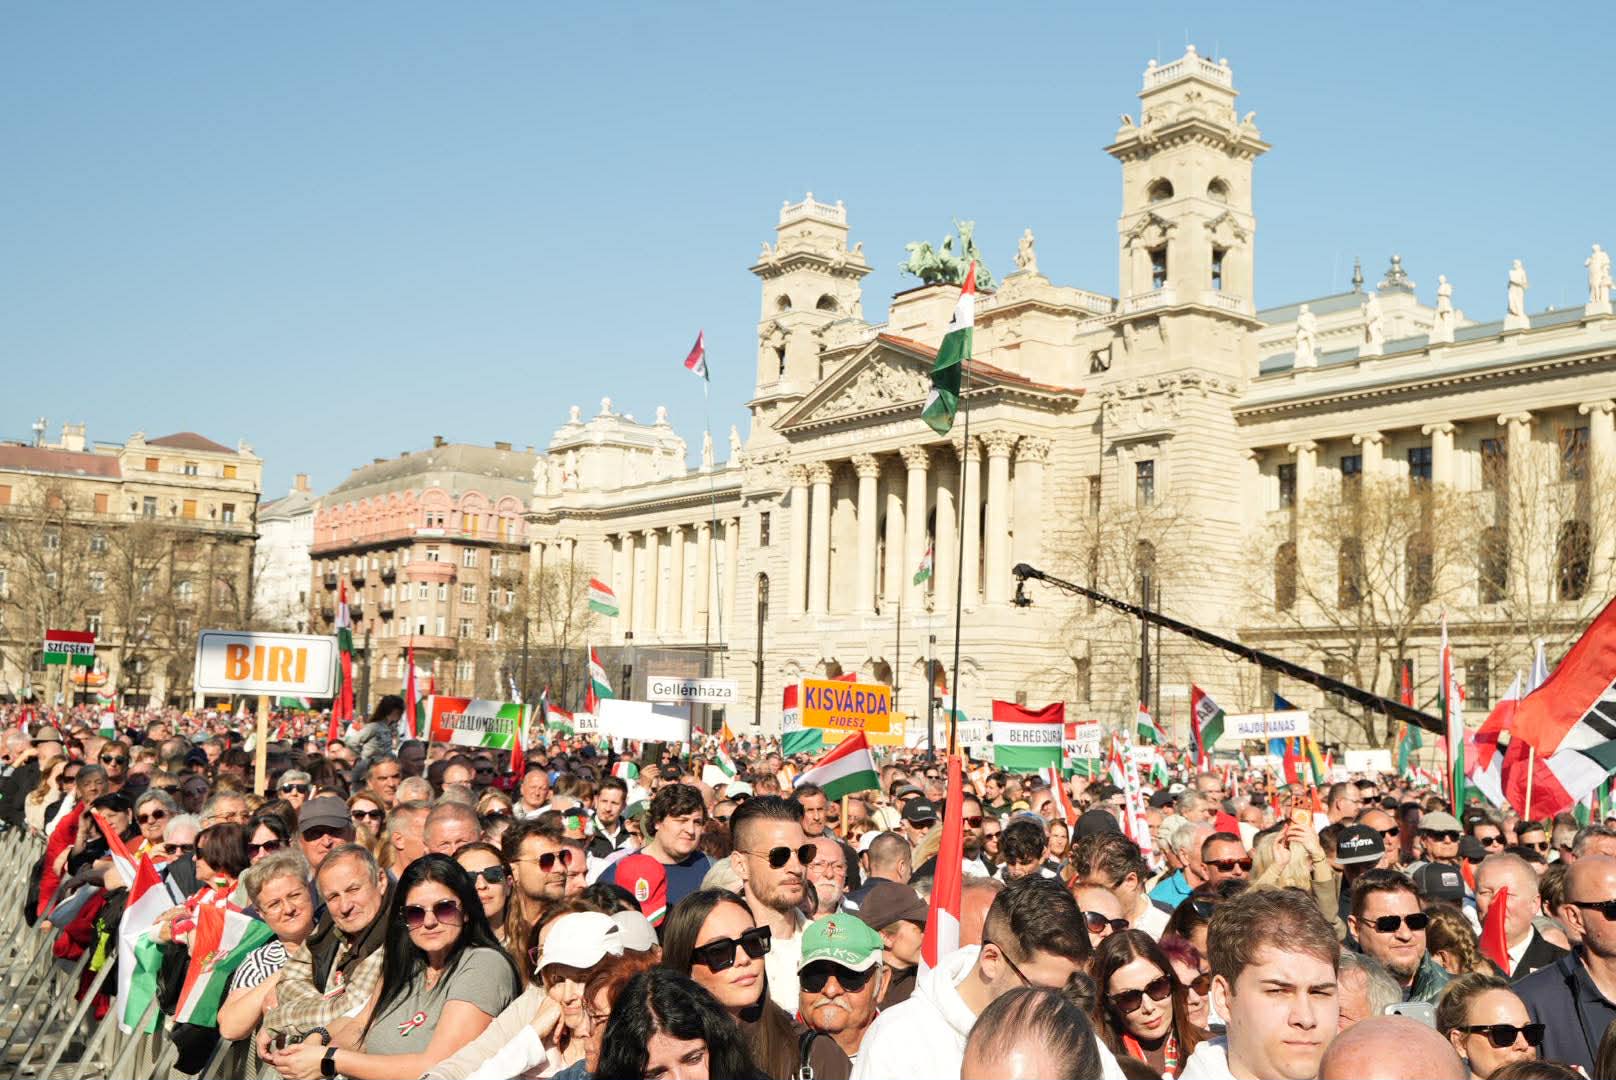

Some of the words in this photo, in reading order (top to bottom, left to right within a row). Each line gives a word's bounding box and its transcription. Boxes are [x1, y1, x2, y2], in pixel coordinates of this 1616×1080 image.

[225, 643, 308, 683] BIRI
[805, 685, 888, 716] KISVÁRDA
[829, 716, 865, 728] FIDESZ
